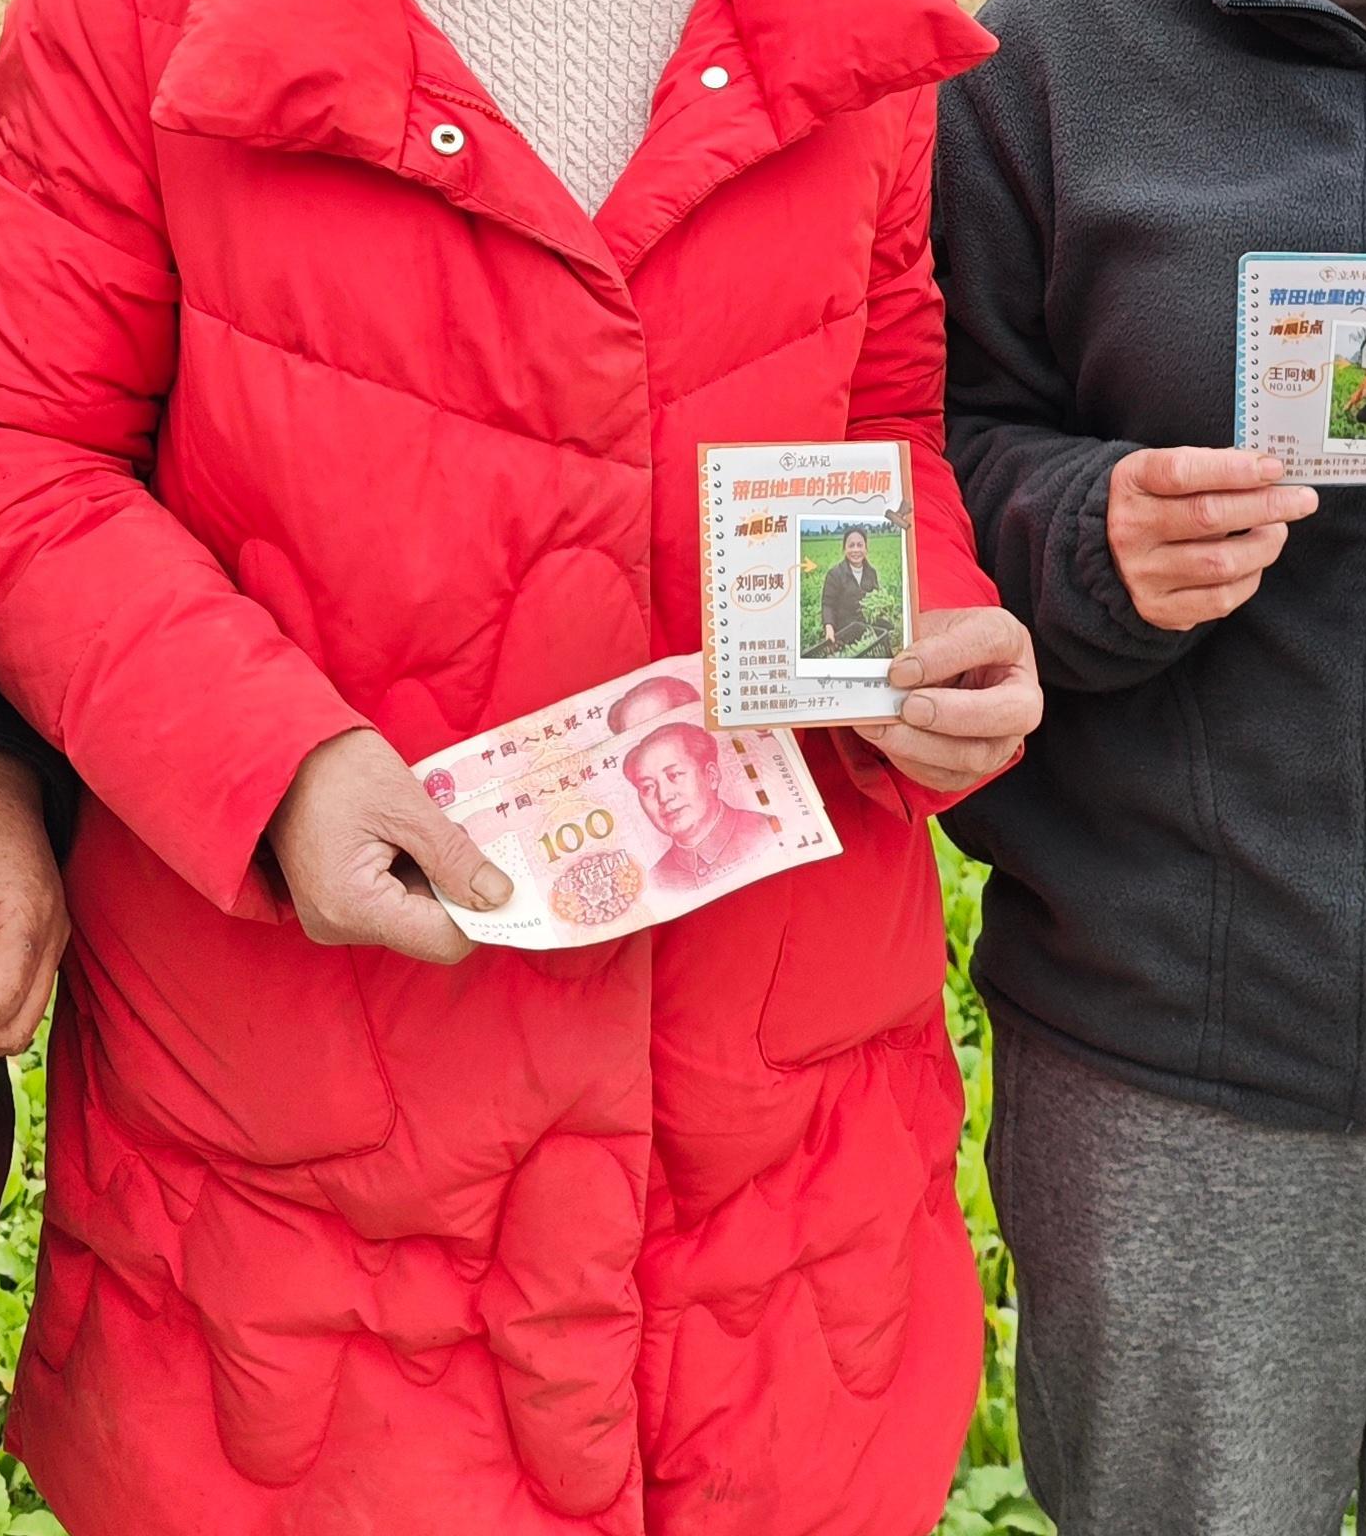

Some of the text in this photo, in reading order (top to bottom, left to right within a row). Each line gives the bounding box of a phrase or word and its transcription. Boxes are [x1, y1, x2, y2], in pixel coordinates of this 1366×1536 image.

[1269, 319, 1324, 336] 清晨6点
[1268, 367, 1316, 382] 王阿姨
[797, 455, 831, 467] 立早记
[732, 470, 892, 501] 菜田地里的采摘师
[734, 515, 788, 537] 清晨6点
[736, 574, 785, 592] 刘阿姨
[737, 593, 772, 603] NO.006
[481, 706, 604, 766] 中国人民银行
[495, 755, 620, 819] 中国人民银行
[536, 808, 616, 864] 100
